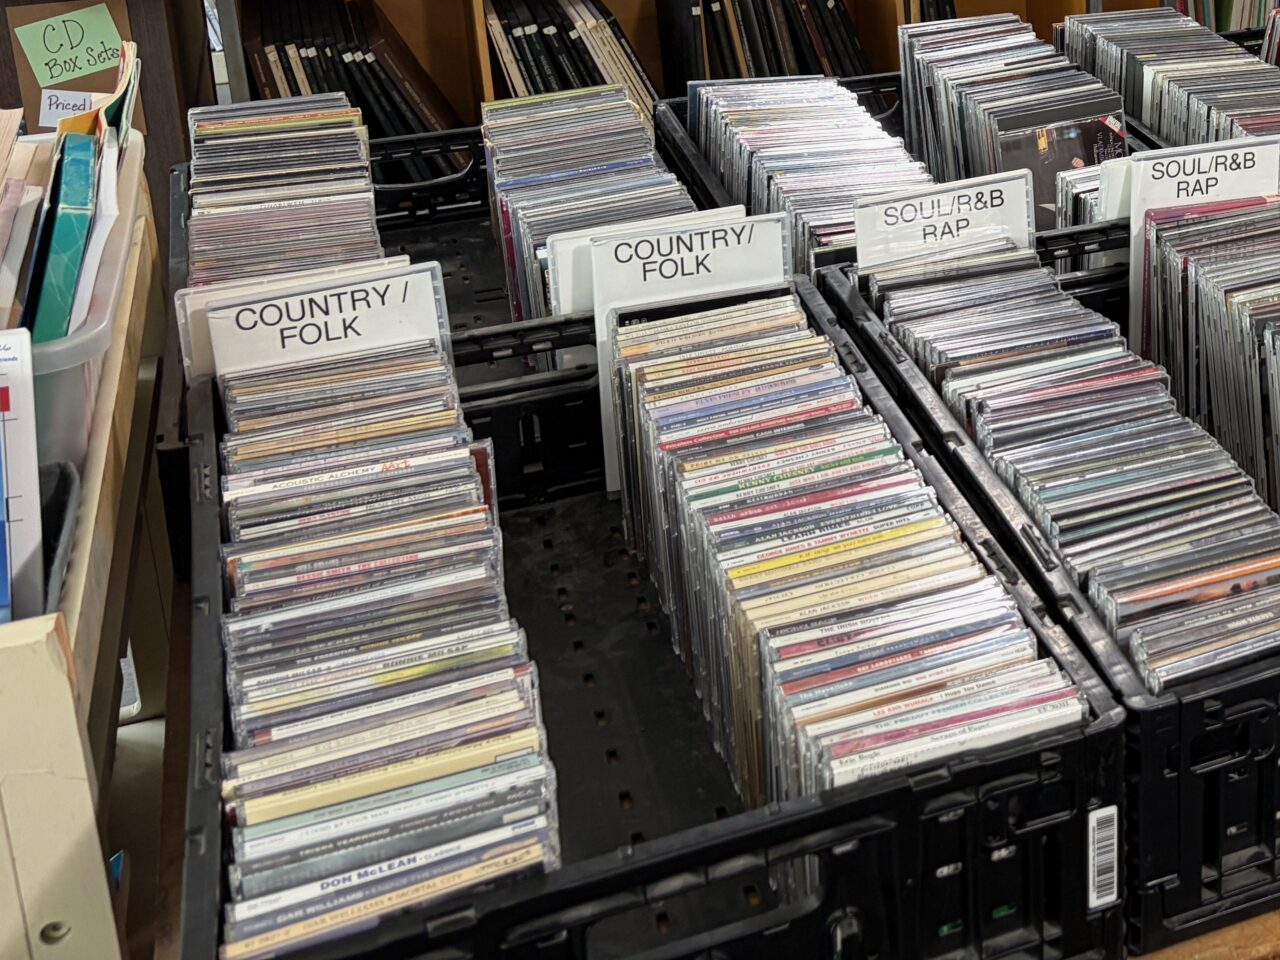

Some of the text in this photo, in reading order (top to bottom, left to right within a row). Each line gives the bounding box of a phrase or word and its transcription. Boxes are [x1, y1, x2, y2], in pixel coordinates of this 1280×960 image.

[42, 19, 84, 53] CD
[45, 41, 121, 79] Box Sets
[1151, 152, 1256, 181] SOUL/R&B
[1177, 177, 1218, 198] RAP
[884, 189, 1004, 226] SOUL/R&B
[614, 223, 755, 264] COUNTRY/
[923, 218, 970, 243] RAP
[642, 253, 711, 282] FOLK
[236, 285, 391, 331] COUNTRY
[280, 316, 361, 349] FOLK
[271, 464, 375, 491] ACOUSTIC ALCHEMY
[738, 466, 815, 489] KENNY CHESNEY
[318, 855, 417, 891] DON McLEAN
